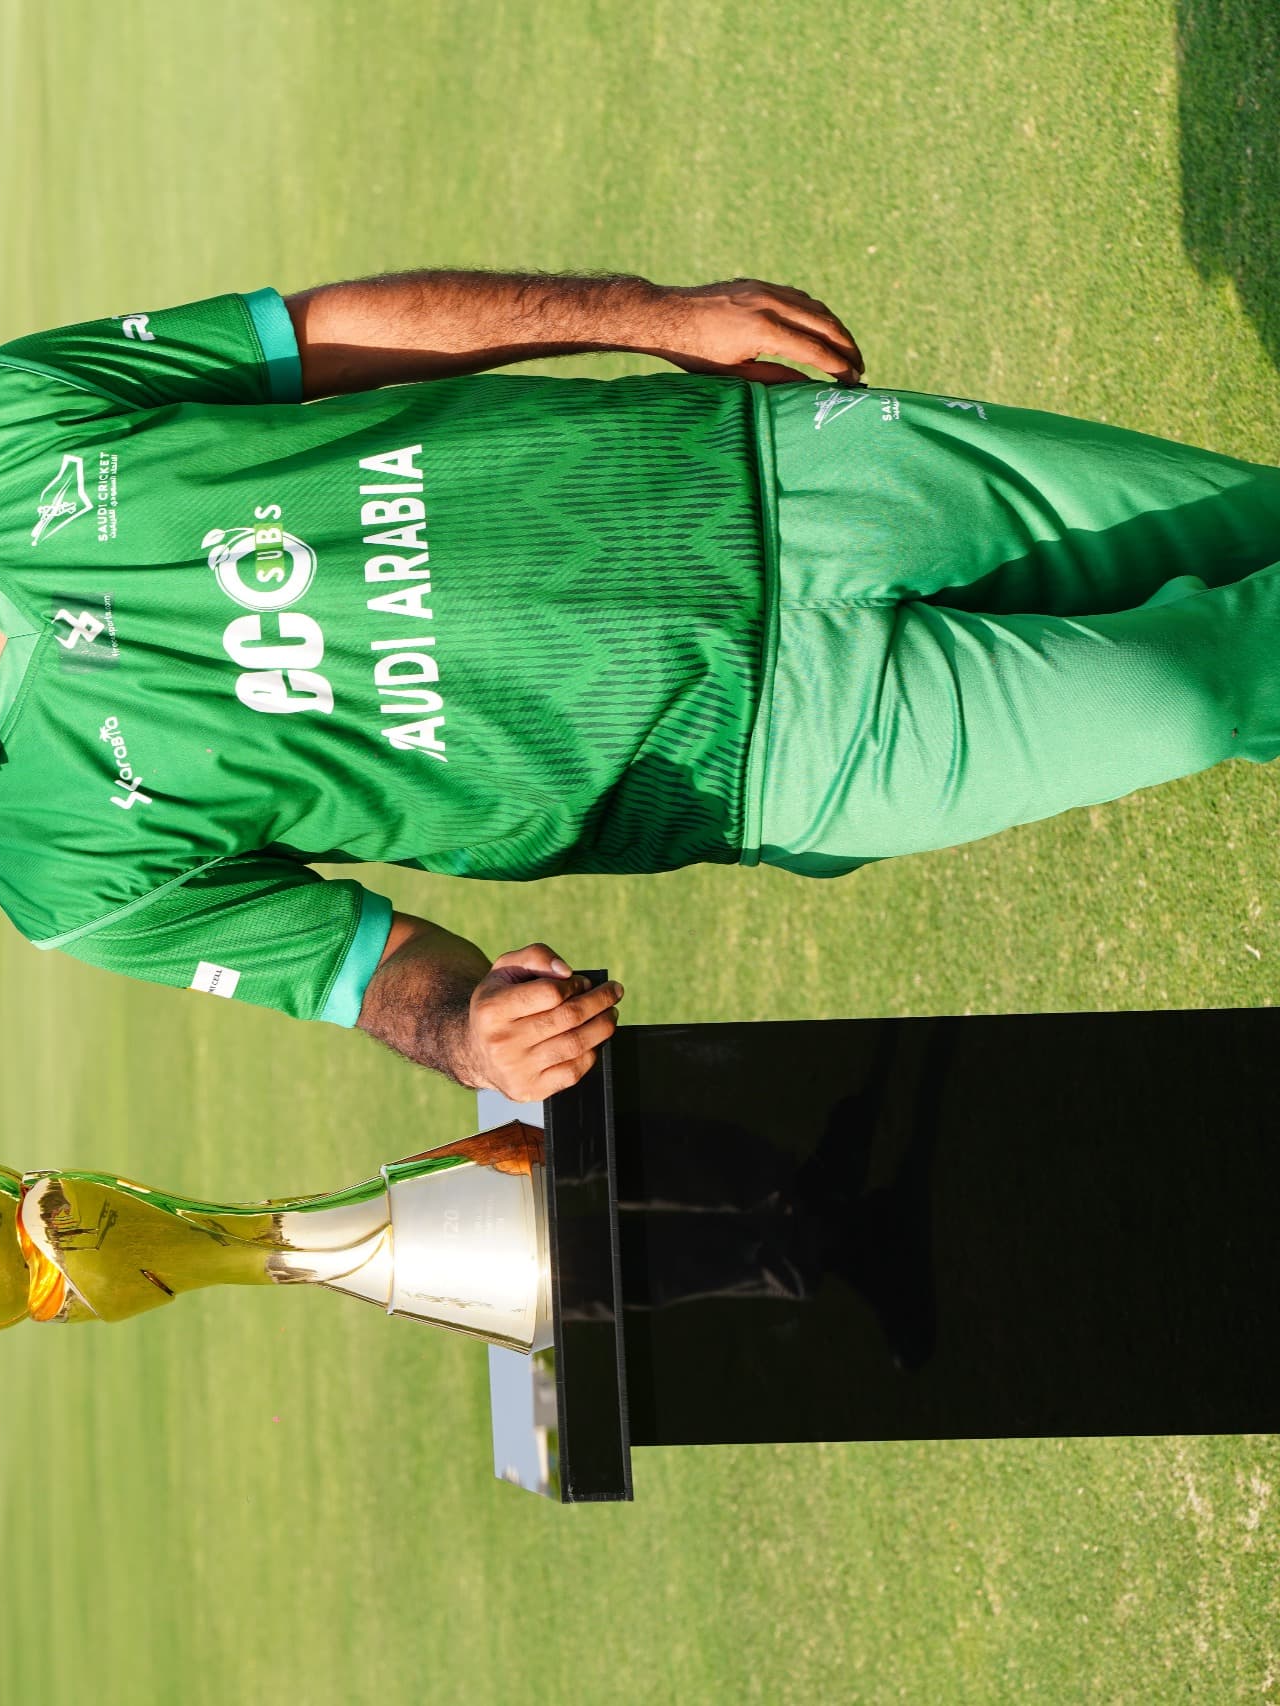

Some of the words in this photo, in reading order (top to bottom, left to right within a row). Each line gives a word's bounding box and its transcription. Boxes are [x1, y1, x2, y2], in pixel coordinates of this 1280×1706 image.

[97, 451, 110, 500] CRICKET
[97, 503, 108, 541] SAUDI
[254, 504, 284, 583] SUBS
[359, 444, 433, 619] ARABIA
